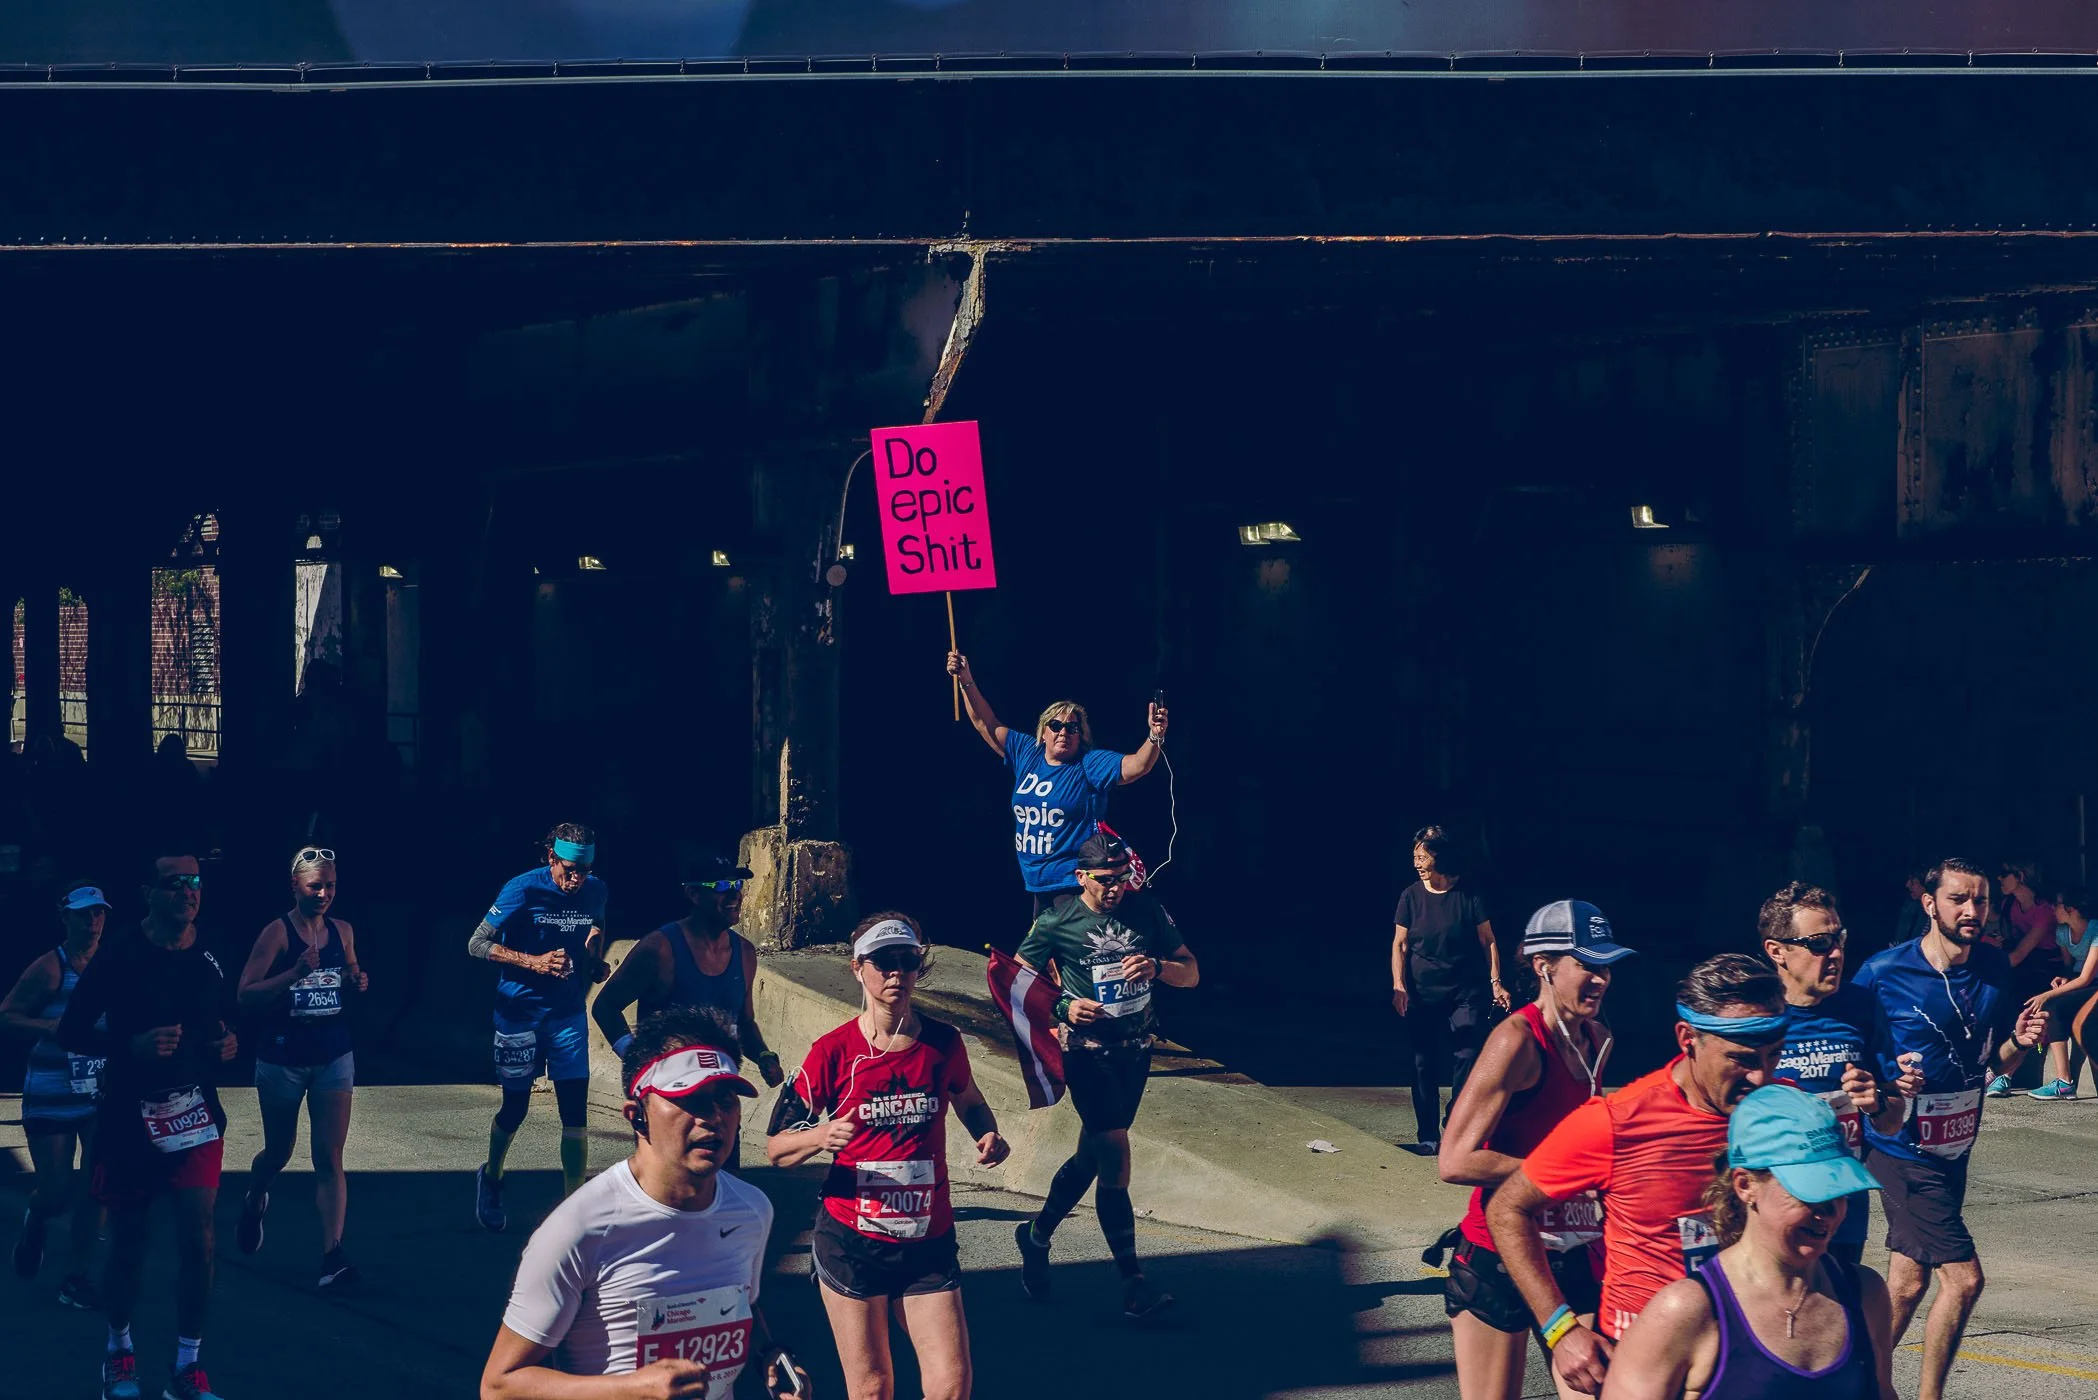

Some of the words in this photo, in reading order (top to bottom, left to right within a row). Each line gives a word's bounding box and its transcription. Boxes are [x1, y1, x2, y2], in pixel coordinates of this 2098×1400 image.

[884, 437, 938, 479] Do
[891, 479, 975, 532] epic
[896, 533, 982, 575] Shit
[1016, 772, 1053, 797] Do
[1013, 801, 1065, 831] epic
[1015, 829, 1055, 855] shit
[538, 915, 567, 926] Chicago
[559, 924, 577, 932] 2017
[294, 992, 301, 1006] F
[307, 990, 338, 1007] 26541
[1098, 985, 1107, 1001] F
[1113, 979, 1150, 1000] 24043
[503, 1047, 536, 1064] 34287
[1777, 1055, 1810, 1069] cago
[72, 1061, 80, 1077] F
[1800, 1064, 1831, 1079] 2017
[858, 1097, 939, 1120] CHICAGO
[147, 1120, 161, 1136] E
[164, 1107, 209, 1133] 10925
[874, 1114, 926, 1127] MARATHON
[1921, 1121, 1932, 1141] D
[1942, 1113, 1975, 1140] 13399
[860, 1190, 871, 1213] E
[880, 1189, 932, 1214] 20074
[1543, 1208, 1555, 1227] E
[666, 1308, 691, 1317] Chicago
[674, 1328, 745, 1366] 12923
